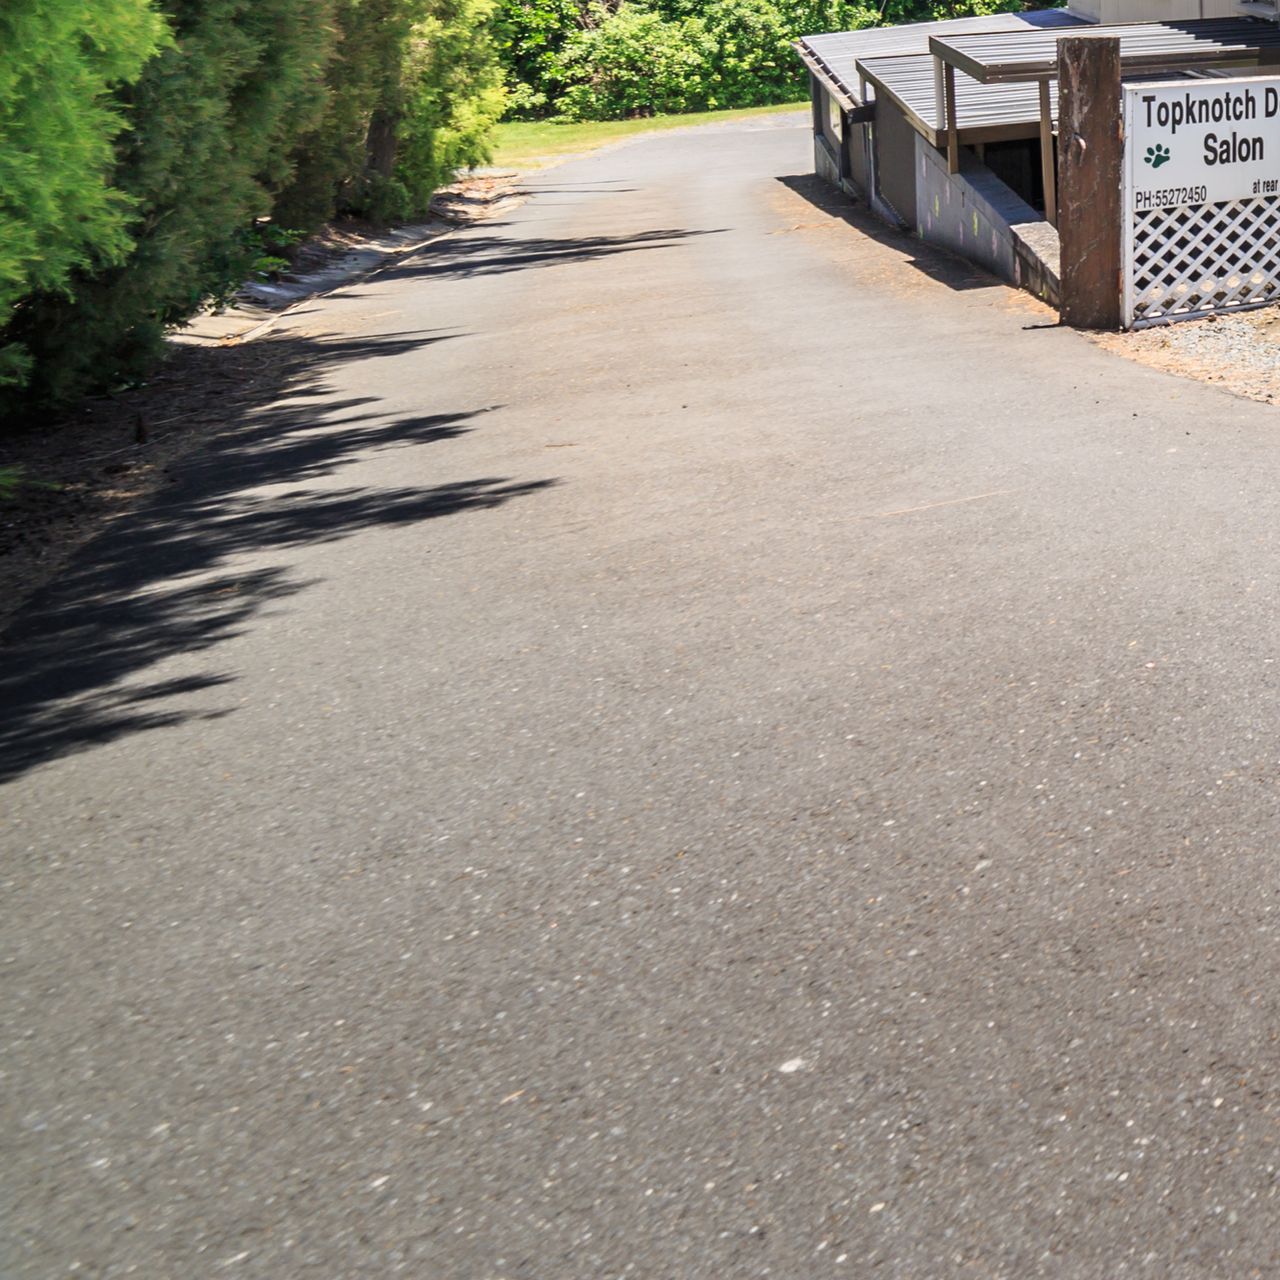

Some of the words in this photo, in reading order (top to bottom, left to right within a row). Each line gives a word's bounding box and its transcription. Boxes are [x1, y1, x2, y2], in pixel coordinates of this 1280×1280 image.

[1142, 89, 1256, 134] Topknotch
[1203, 131, 1264, 166] Salon
[1135, 185, 1207, 209] PH:55272450
[1252, 178, 1261, 194] at
[1262, 179, 1279, 193] rear
